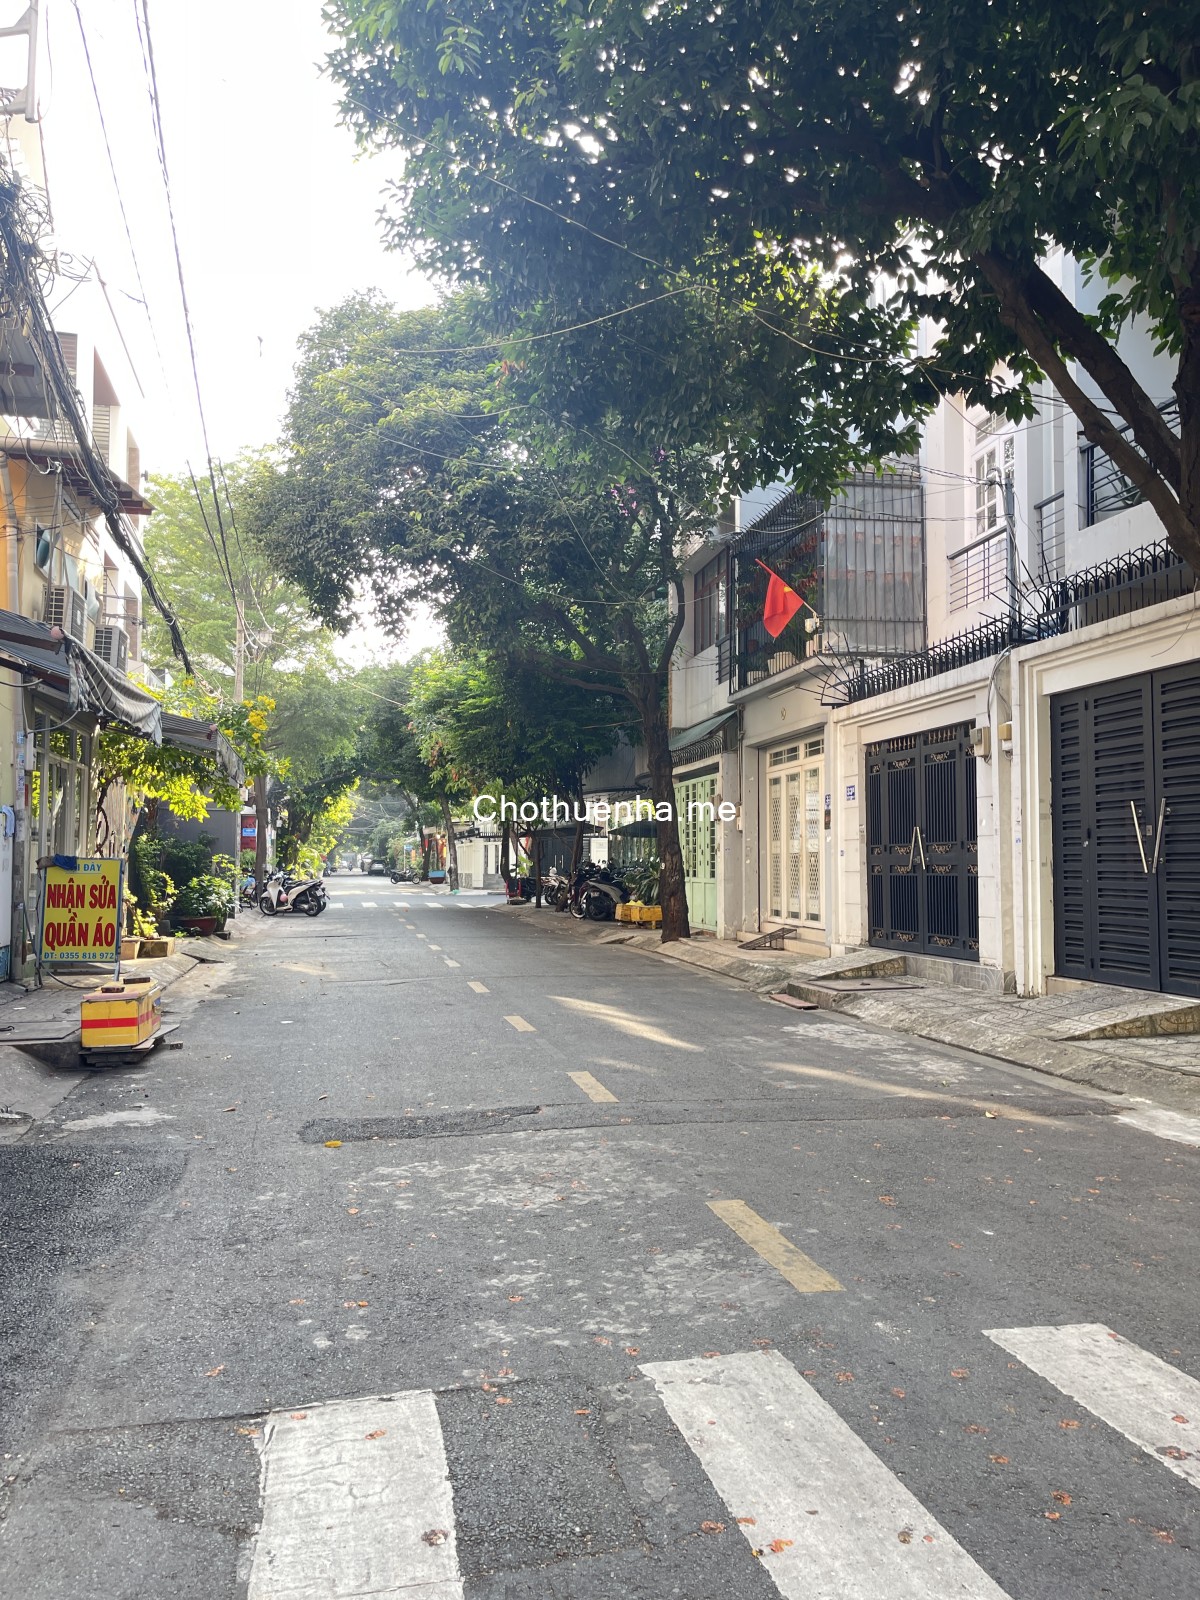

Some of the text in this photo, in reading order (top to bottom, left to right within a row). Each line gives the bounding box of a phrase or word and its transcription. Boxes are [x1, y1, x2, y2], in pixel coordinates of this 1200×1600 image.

[83, 862, 102, 871] ĐÂY
[46, 875, 117, 914] NHẬN SỬA
[44, 912, 116, 951] QUẦN ÁO
[44, 952, 114, 960] ĐT: 0355 818 972
